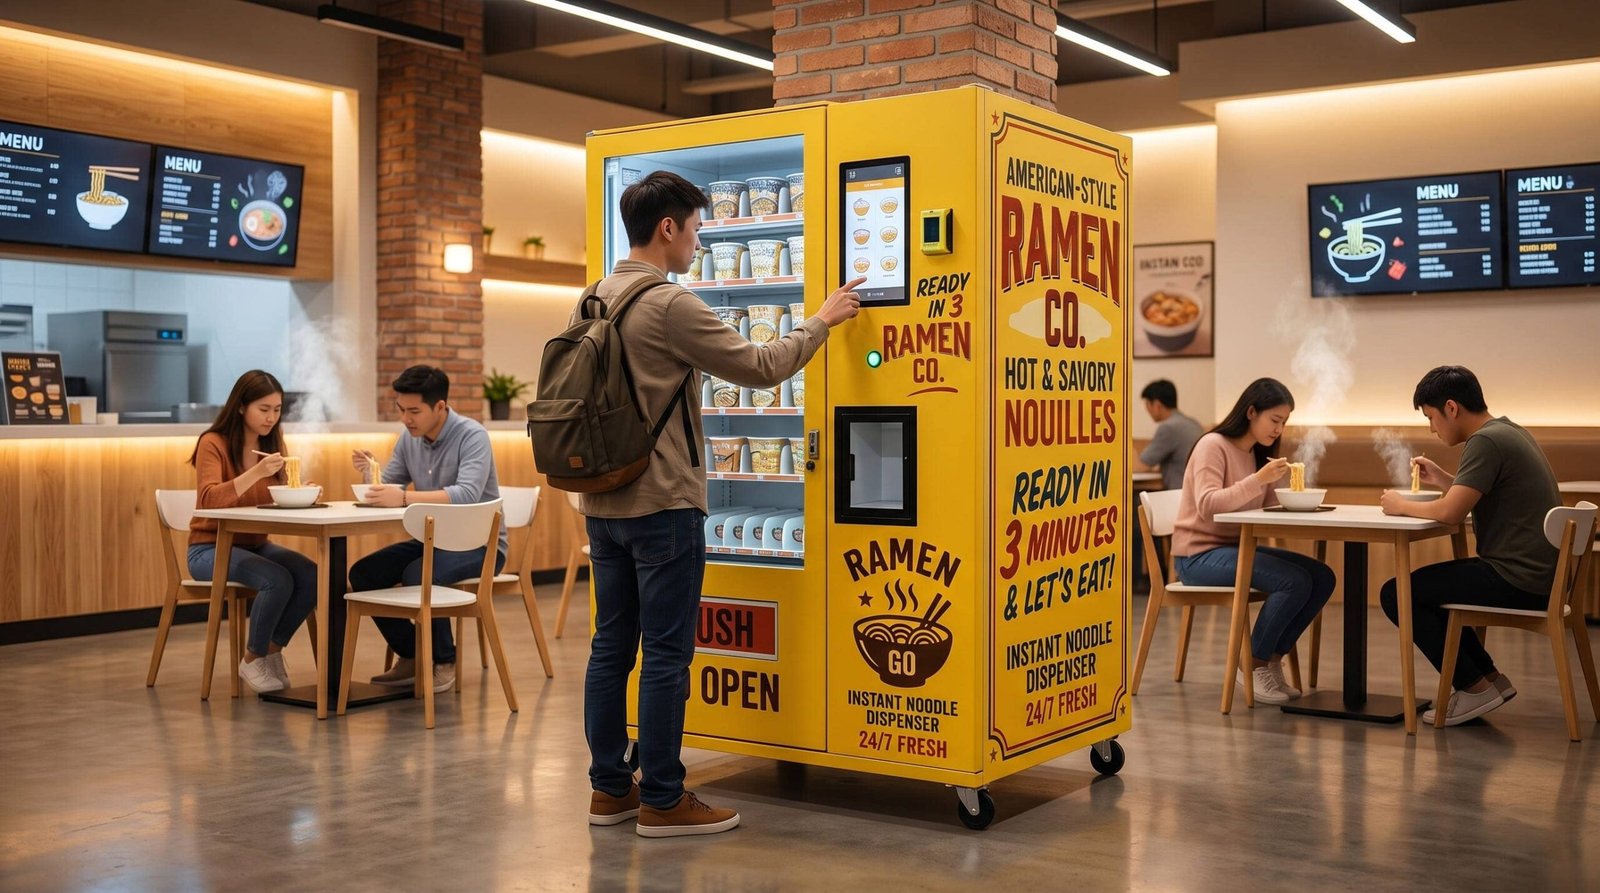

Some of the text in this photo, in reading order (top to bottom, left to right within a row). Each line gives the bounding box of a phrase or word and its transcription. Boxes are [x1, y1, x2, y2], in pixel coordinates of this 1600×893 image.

[0, 132, 43, 151] MENU
[165, 156, 201, 173] MENU
[1007, 157, 1117, 211] AMERICAN-STYLE
[1517, 175, 1562, 192] MENU
[1416, 183, 1459, 200] MENU
[1001, 194, 1120, 308] RAMEN
[916, 272, 970, 297] READY
[928, 293, 963, 318] IN 3
[1045, 288, 1086, 349] CO.
[883, 321, 971, 363] RAMEN
[913, 357, 945, 383] CO.
[1005, 357, 1116, 392] HOT & SAVORY
[1005, 399, 1116, 447] NOUILLES
[1012, 459, 1111, 515] READY IN
[843, 537, 961, 588] RAMEN
[1000, 505, 1118, 580] 3 MINUTES
[1003, 553, 1115, 621] & LET'S EAT!
[697, 607, 753, 648] USH
[1007, 621, 1112, 670] INSTANT NOODLE
[888, 650, 916, 676] GO
[1026, 652, 1096, 694] DISPENSER
[701, 665, 779, 712] OPEN
[848, 690, 958, 717] INSTANT NOODLE
[1026, 683, 1097, 727] 24/7 FRESH
[866, 710, 939, 733] DISPENSER
[859, 730, 947, 759] 24/7 FRESH
